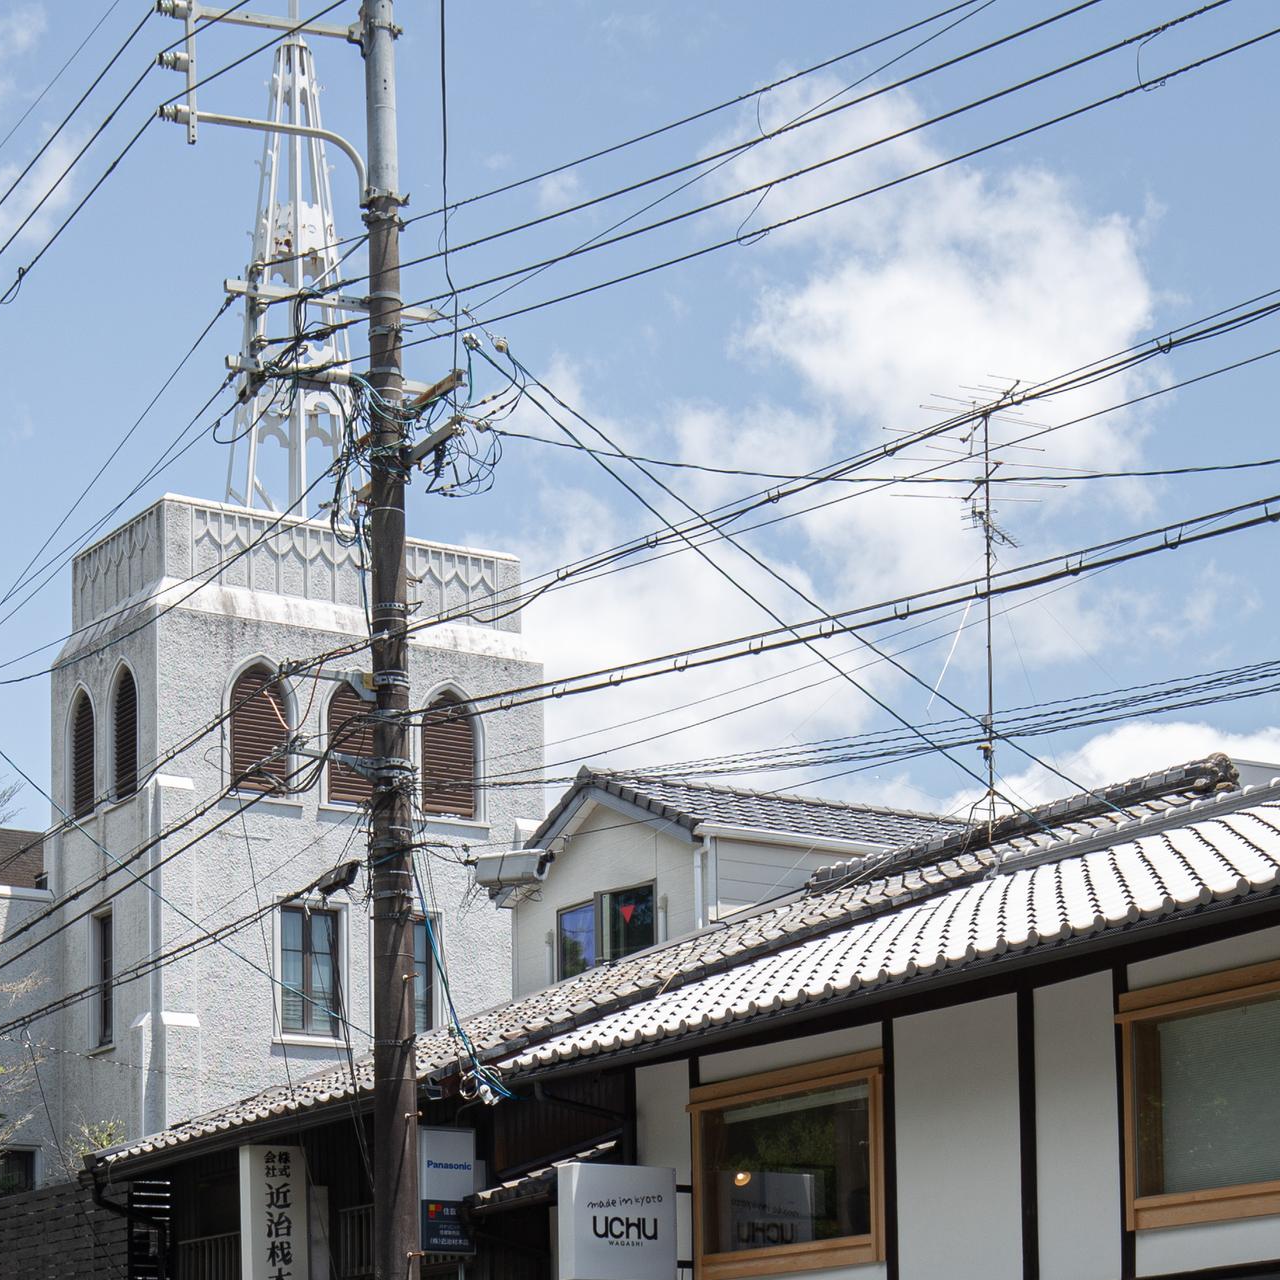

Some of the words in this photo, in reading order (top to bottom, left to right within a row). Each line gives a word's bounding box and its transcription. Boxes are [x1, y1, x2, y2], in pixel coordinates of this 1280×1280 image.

[427, 1160, 472, 1170] Panasonic
[587, 1199, 617, 1209] made
[619, 1196, 633, 1206] in
